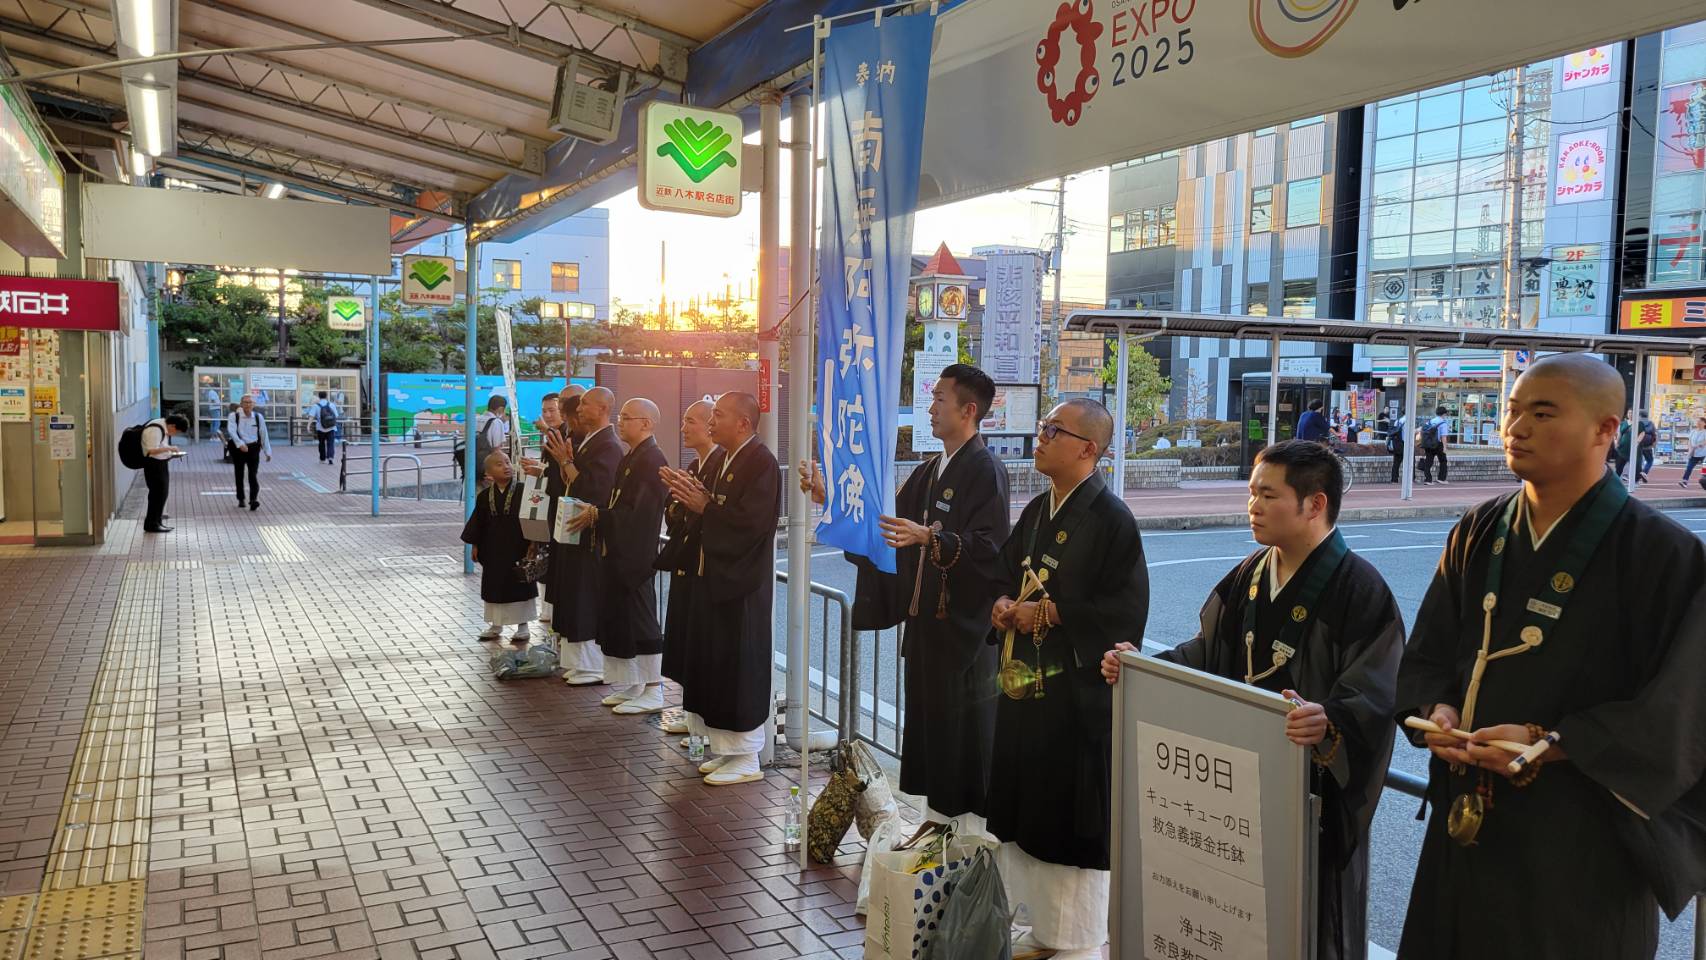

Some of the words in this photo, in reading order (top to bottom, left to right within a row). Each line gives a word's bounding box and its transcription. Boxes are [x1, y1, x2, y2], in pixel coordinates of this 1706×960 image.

[1111, 0, 1196, 48] EXPO
[1111, 28, 1194, 87] 2025
[1564, 64, 1610, 82] ジャンカラ
[675, 188, 735, 206] 八木駅名店街
[1557, 181, 1603, 196] ジャンカラ
[1566, 250, 1585, 263] 2F
[1640, 303, 1663, 325] 薬
[1155, 742, 1234, 794] 9月9日
[1146, 786, 1251, 839] キューキューの日
[1152, 815, 1246, 866] 救急義援金托鉢
[1151, 871, 1254, 923] お力添えをお願い申し上げます
[1152, 933, 1209, 960] 奈良教
[1178, 914, 1224, 953] 浄土宗
